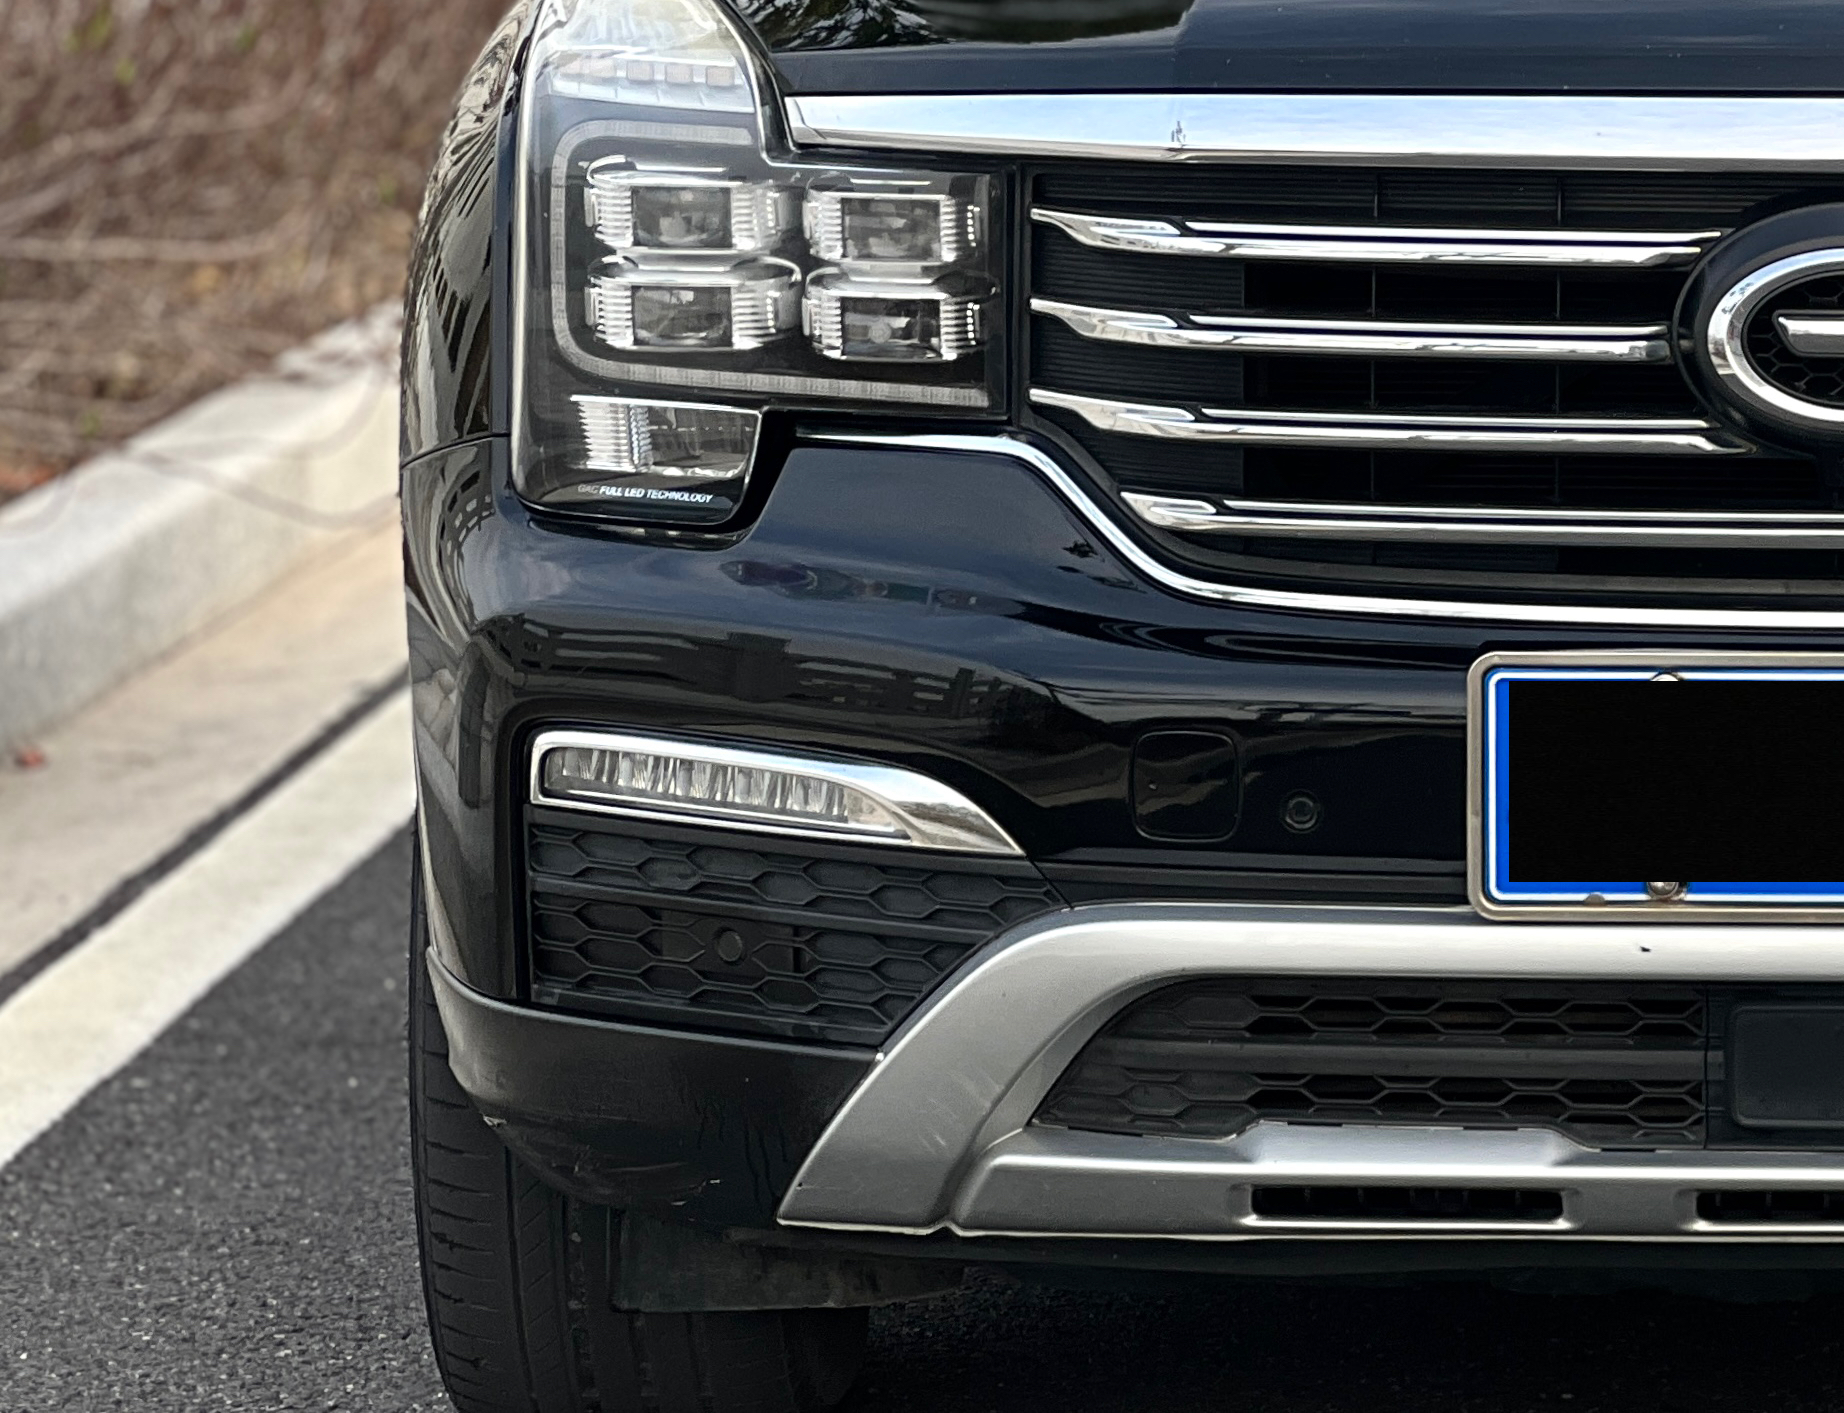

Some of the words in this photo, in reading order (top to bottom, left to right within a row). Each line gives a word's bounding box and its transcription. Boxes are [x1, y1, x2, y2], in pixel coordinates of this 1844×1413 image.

[599, 485, 623, 497] FULL
[624, 487, 646, 498] LED
[646, 488, 713, 503] TECHNOLOGY
